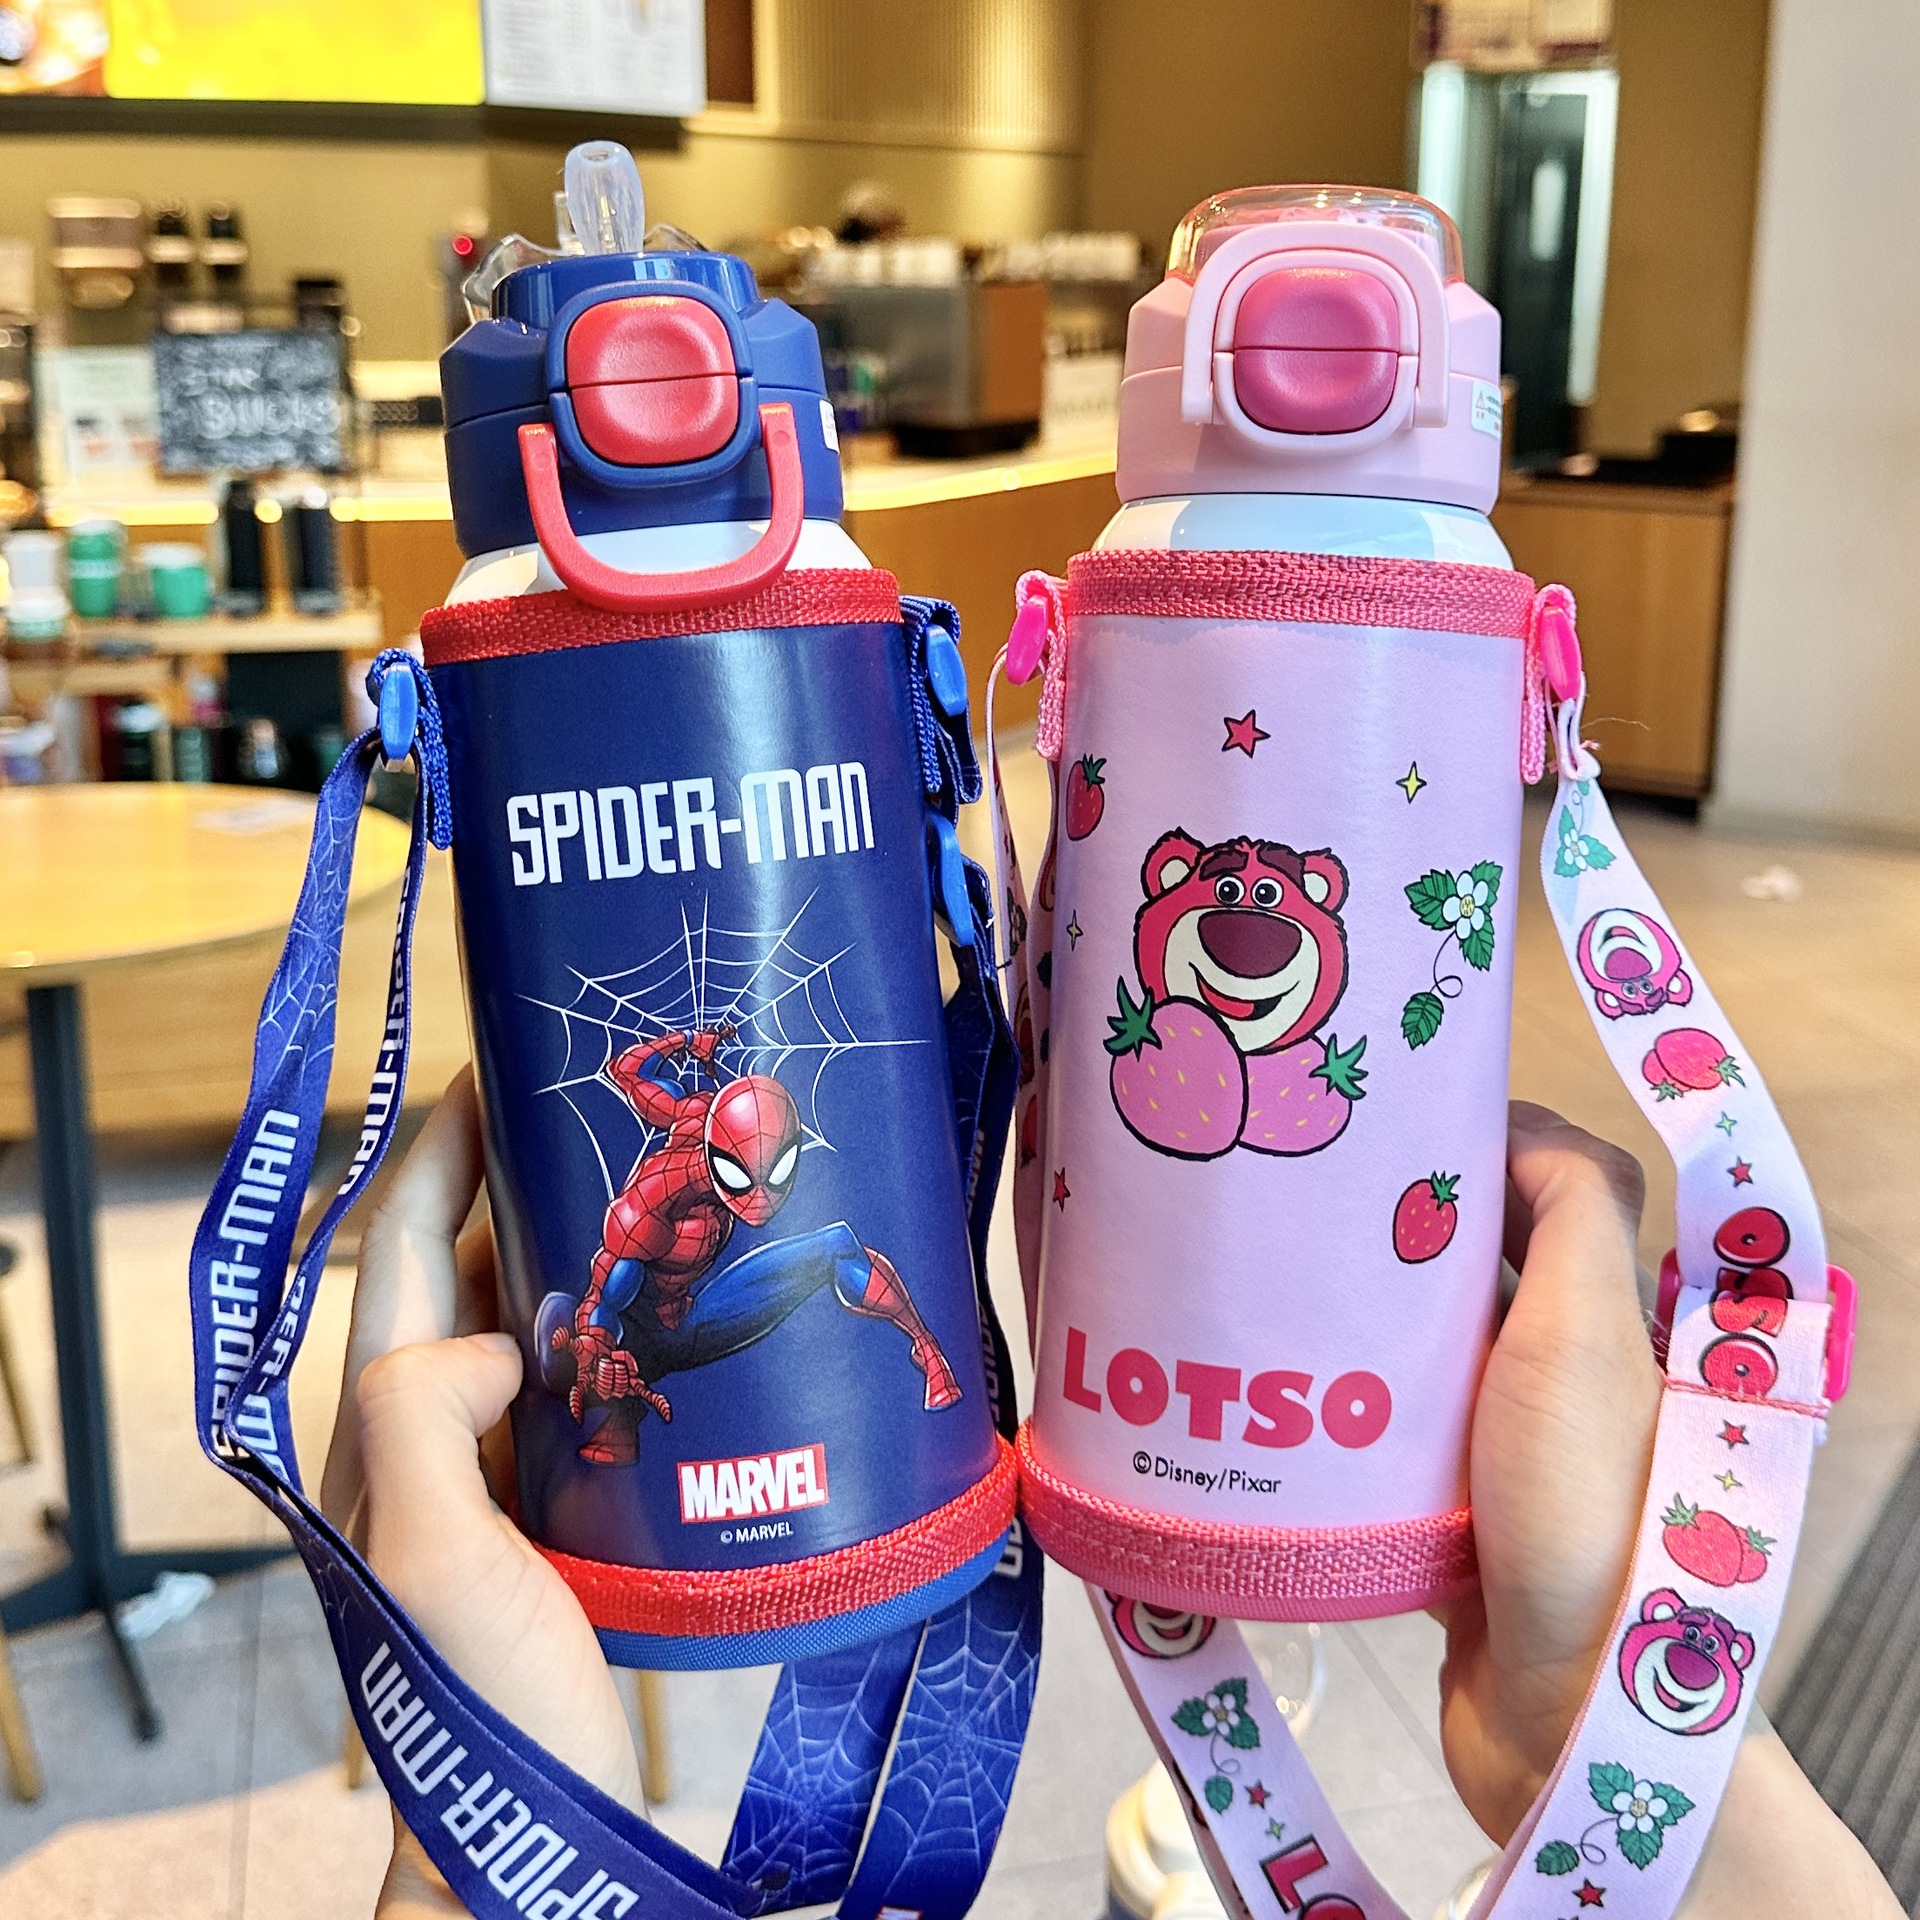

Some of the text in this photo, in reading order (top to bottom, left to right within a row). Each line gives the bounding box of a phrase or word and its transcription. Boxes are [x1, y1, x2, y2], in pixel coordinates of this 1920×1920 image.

[506, 761, 875, 887] SPIDER-MAN
[1063, 1326, 1392, 1449] LOTSO
[681, 1448, 826, 1520] MARVEL
[735, 1521, 794, 1543] MARVEL
